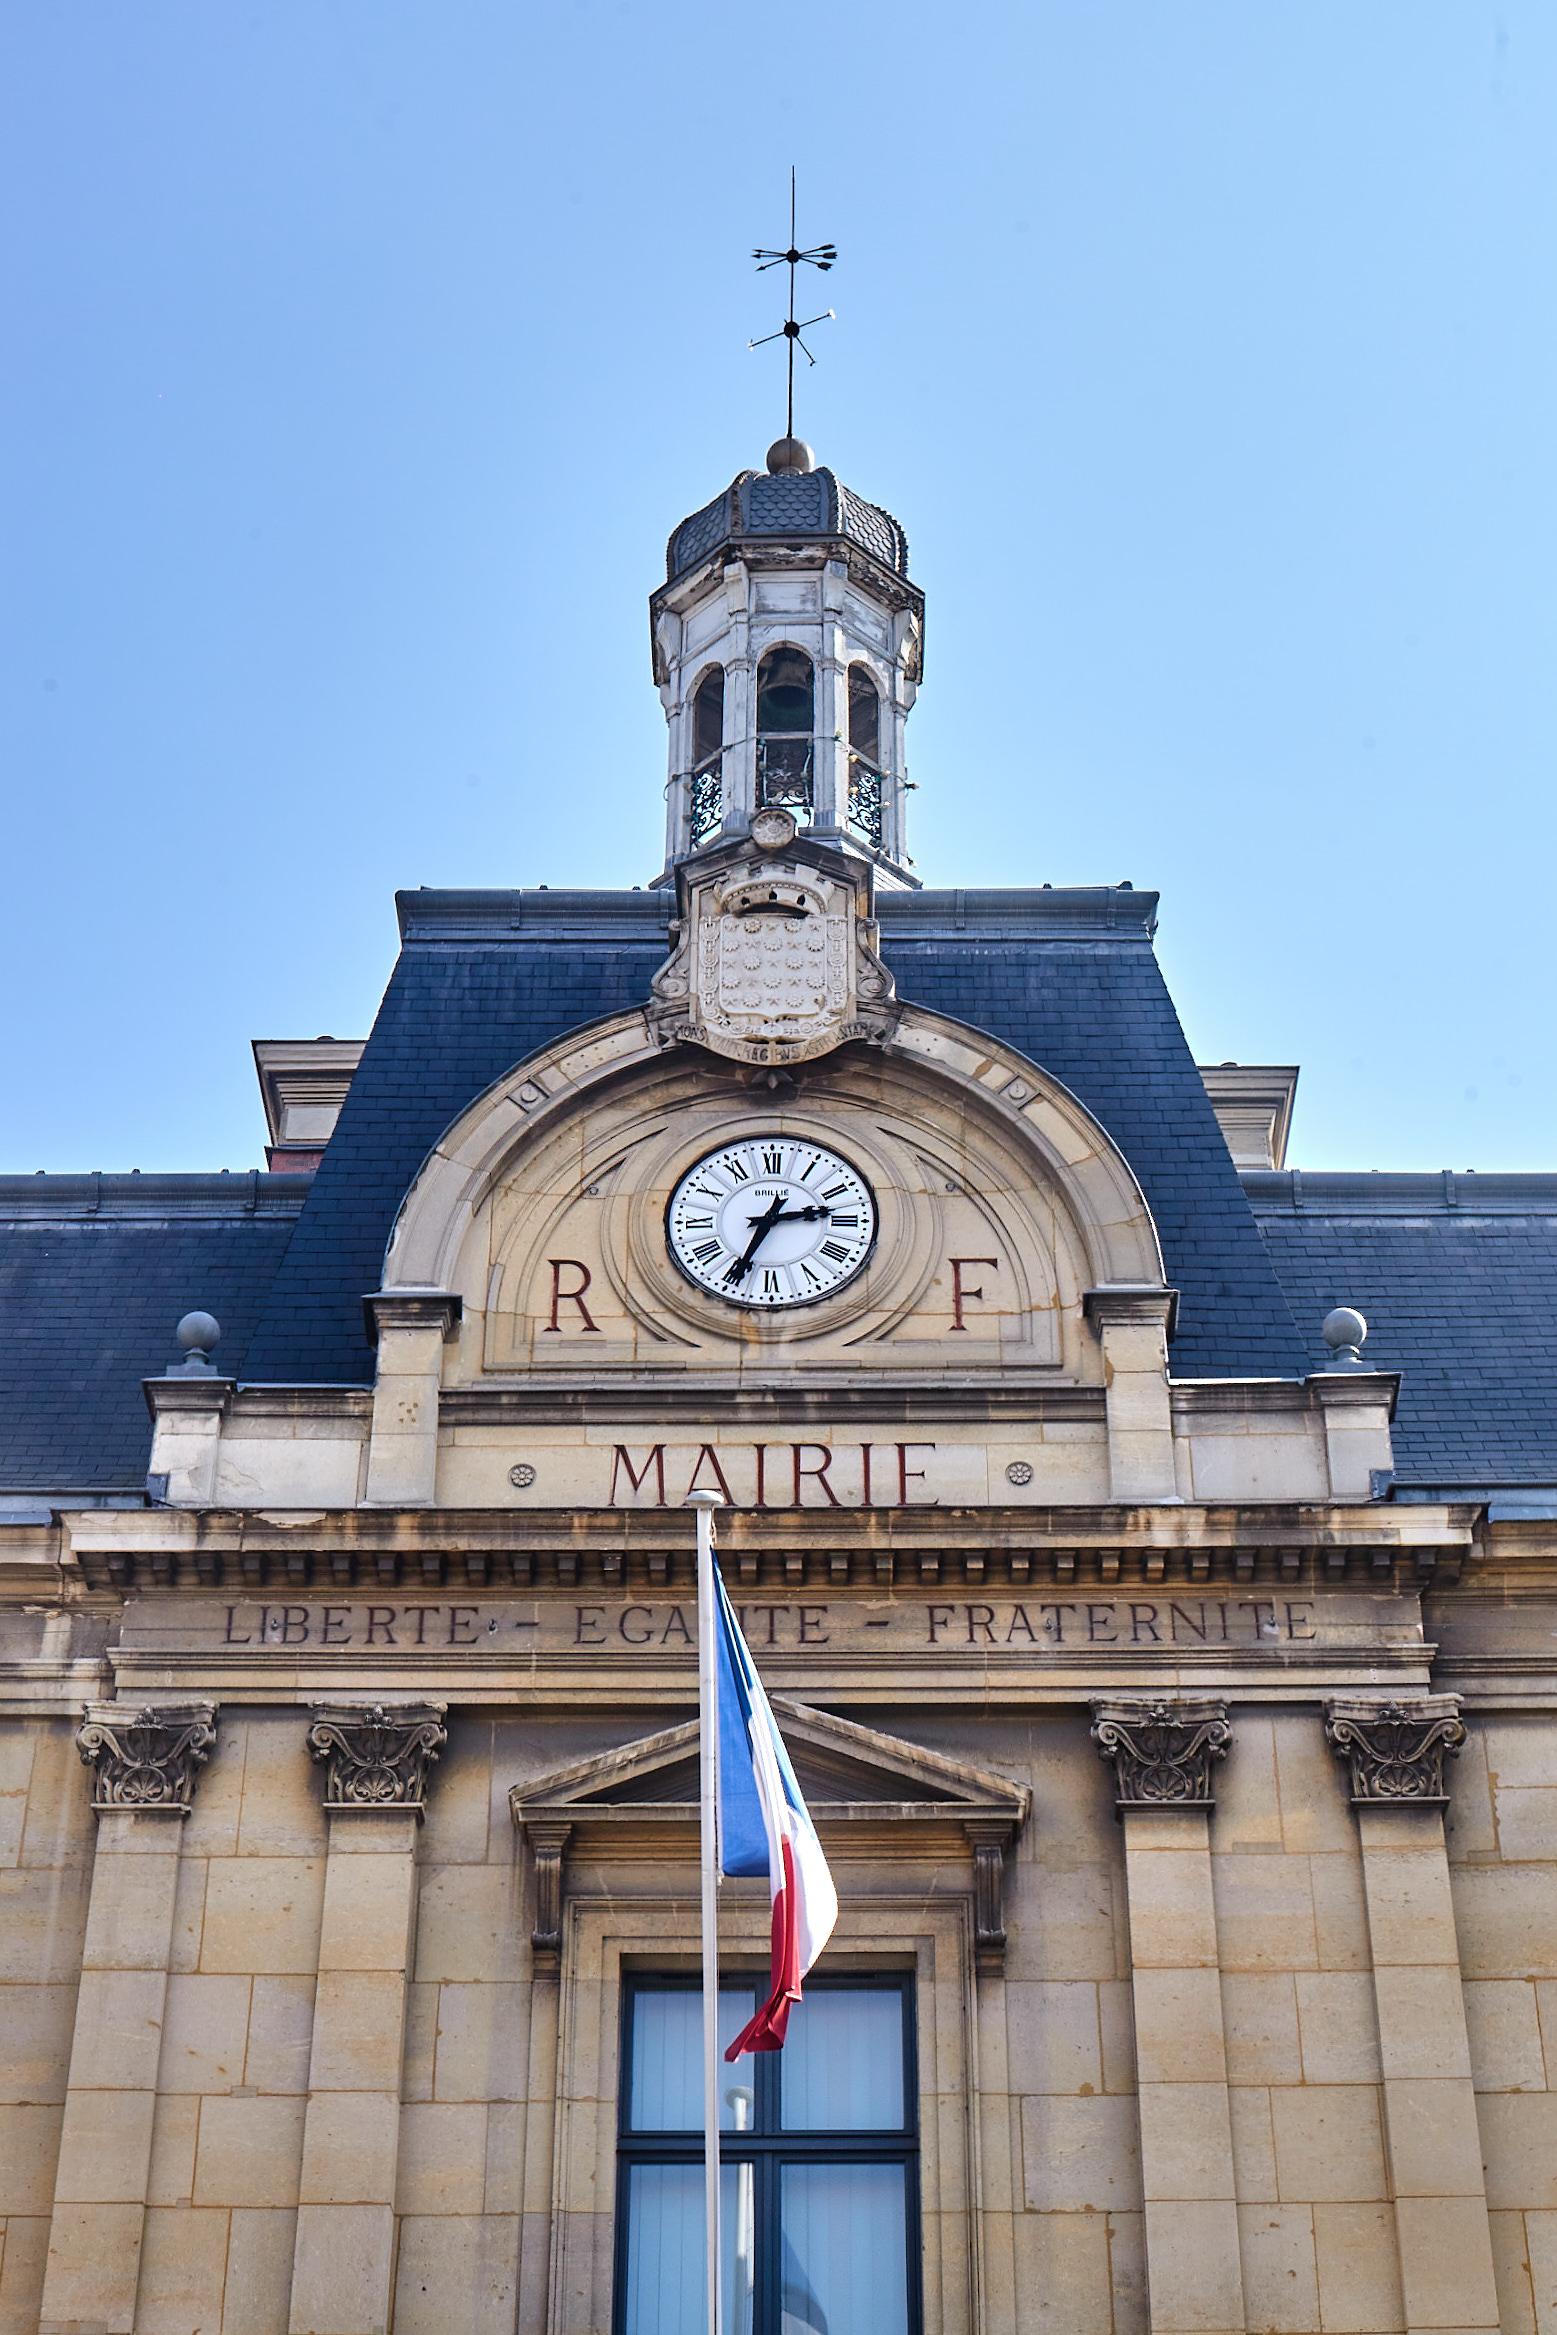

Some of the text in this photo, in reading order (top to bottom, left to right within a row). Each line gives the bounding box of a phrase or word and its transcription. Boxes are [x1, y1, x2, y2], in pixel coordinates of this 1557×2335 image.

[723, 1159, 749, 1184] XI
[763, 1152, 781, 1175] XII
[696, 1183, 724, 1202] X
[821, 1183, 849, 1200] II
[685, 1216, 713, 1230] IX
[831, 1215, 858, 1228] III
[691, 1239, 724, 1266] VIII
[764, 1270, 780, 1293] VI
[801, 1263, 820, 1285] V
[542, 1257, 999, 1332] R F
[609, 1442, 940, 1508] MAIRIE
[221, 1606, 480, 1645] LIBERTE
[573, 1605, 831, 1645] EGAITE
[926, 1601, 1318, 1643] FRATERNITE
